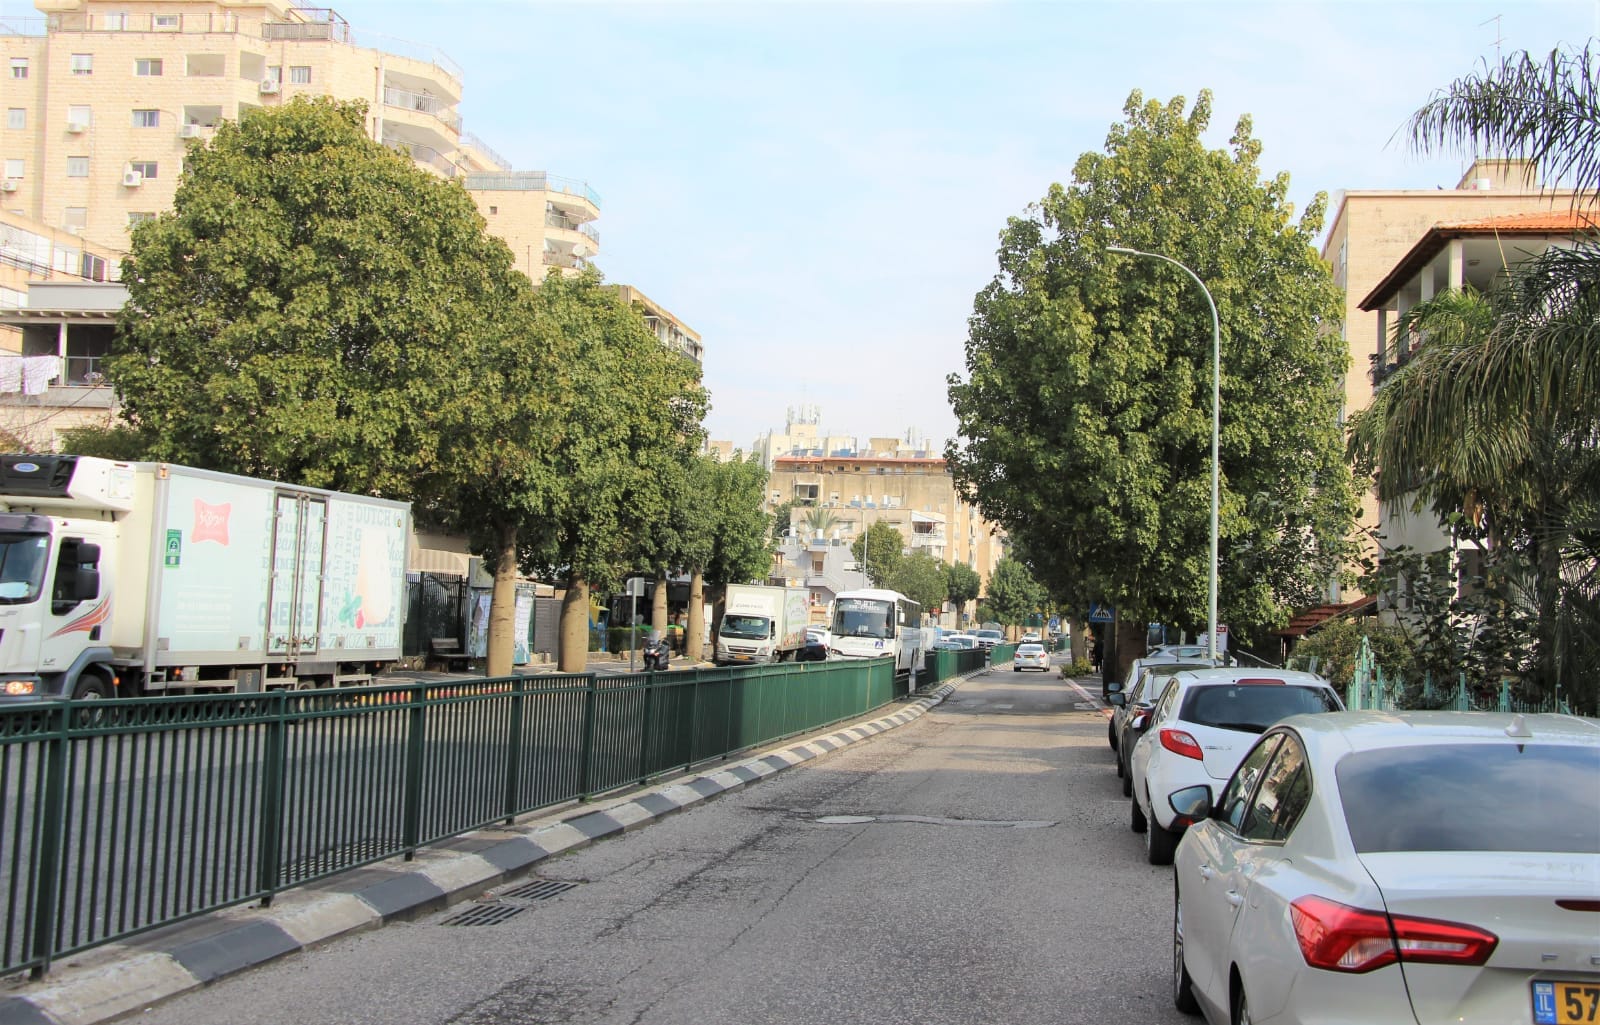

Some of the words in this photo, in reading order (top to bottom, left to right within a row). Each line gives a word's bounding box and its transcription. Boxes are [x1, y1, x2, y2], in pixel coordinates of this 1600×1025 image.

[356, 505, 391, 528] DUTCH
[258, 600, 313, 627] CHESE
[1539, 994, 1553, 1011] IL
[1565, 987, 1600, 1021] 57
